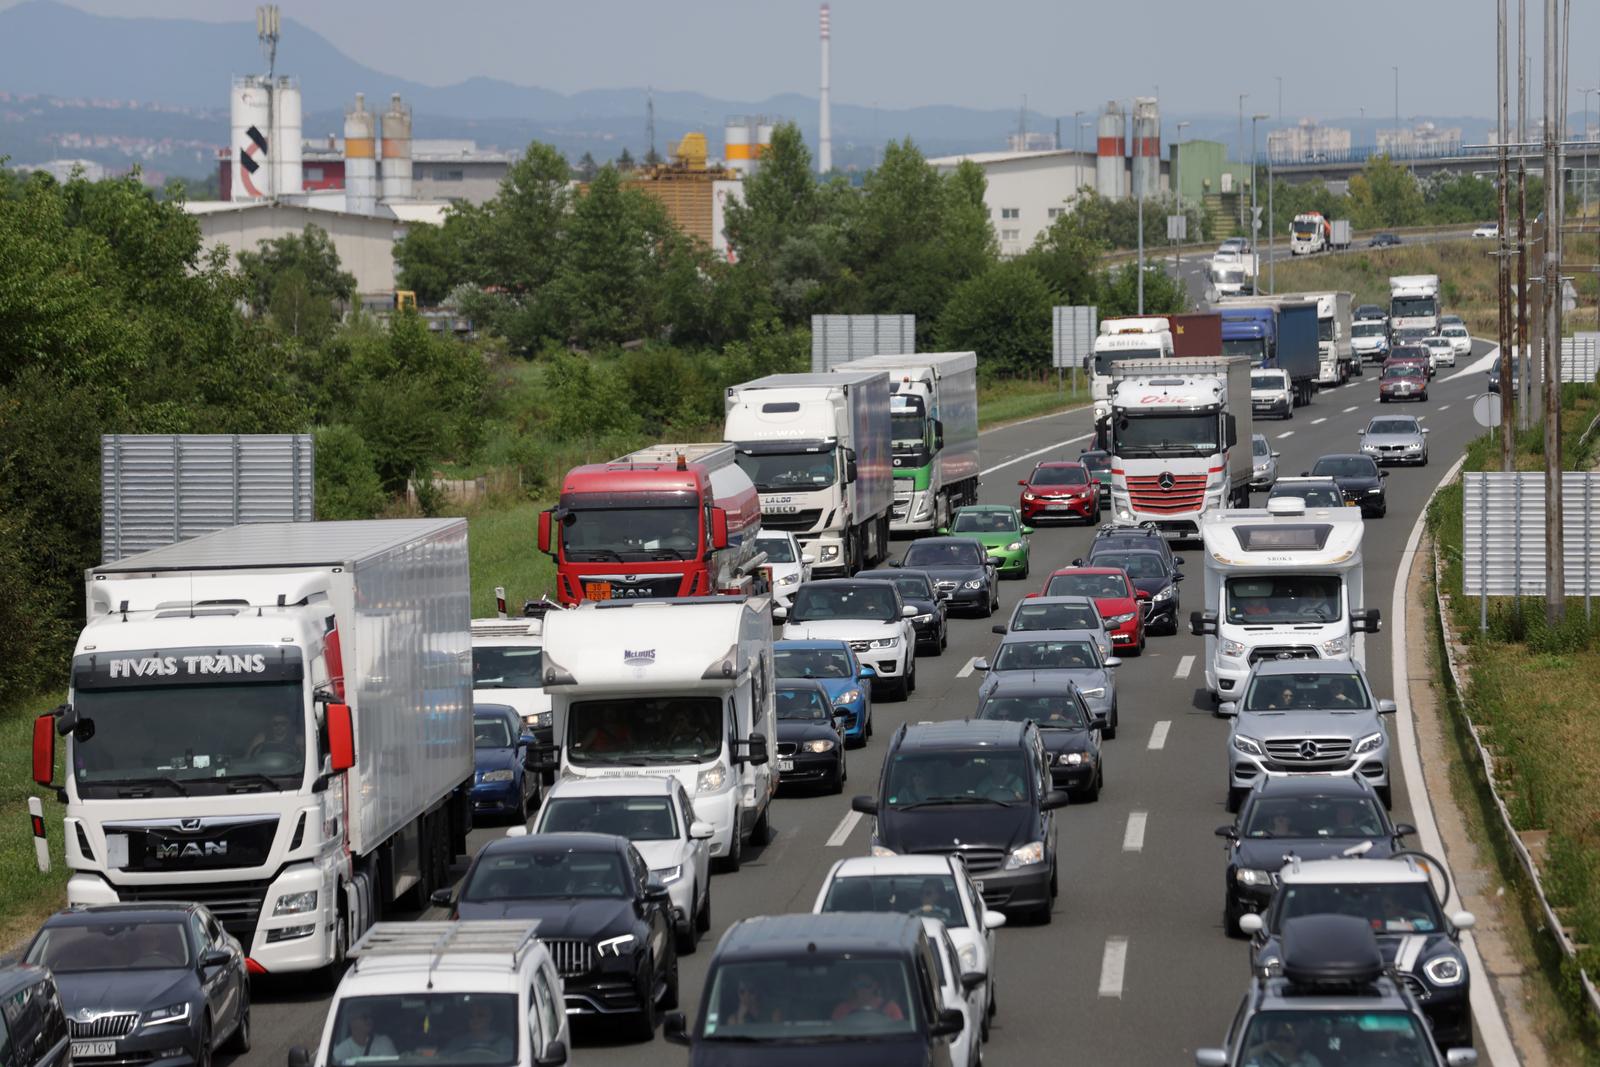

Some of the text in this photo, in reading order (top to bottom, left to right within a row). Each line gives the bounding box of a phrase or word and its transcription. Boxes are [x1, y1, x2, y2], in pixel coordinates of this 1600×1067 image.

[764, 506, 796, 514] IVECO
[611, 588, 653, 598] MAN
[109, 653, 266, 679] FIVAS TRANS
[156, 840, 228, 860] MAN
